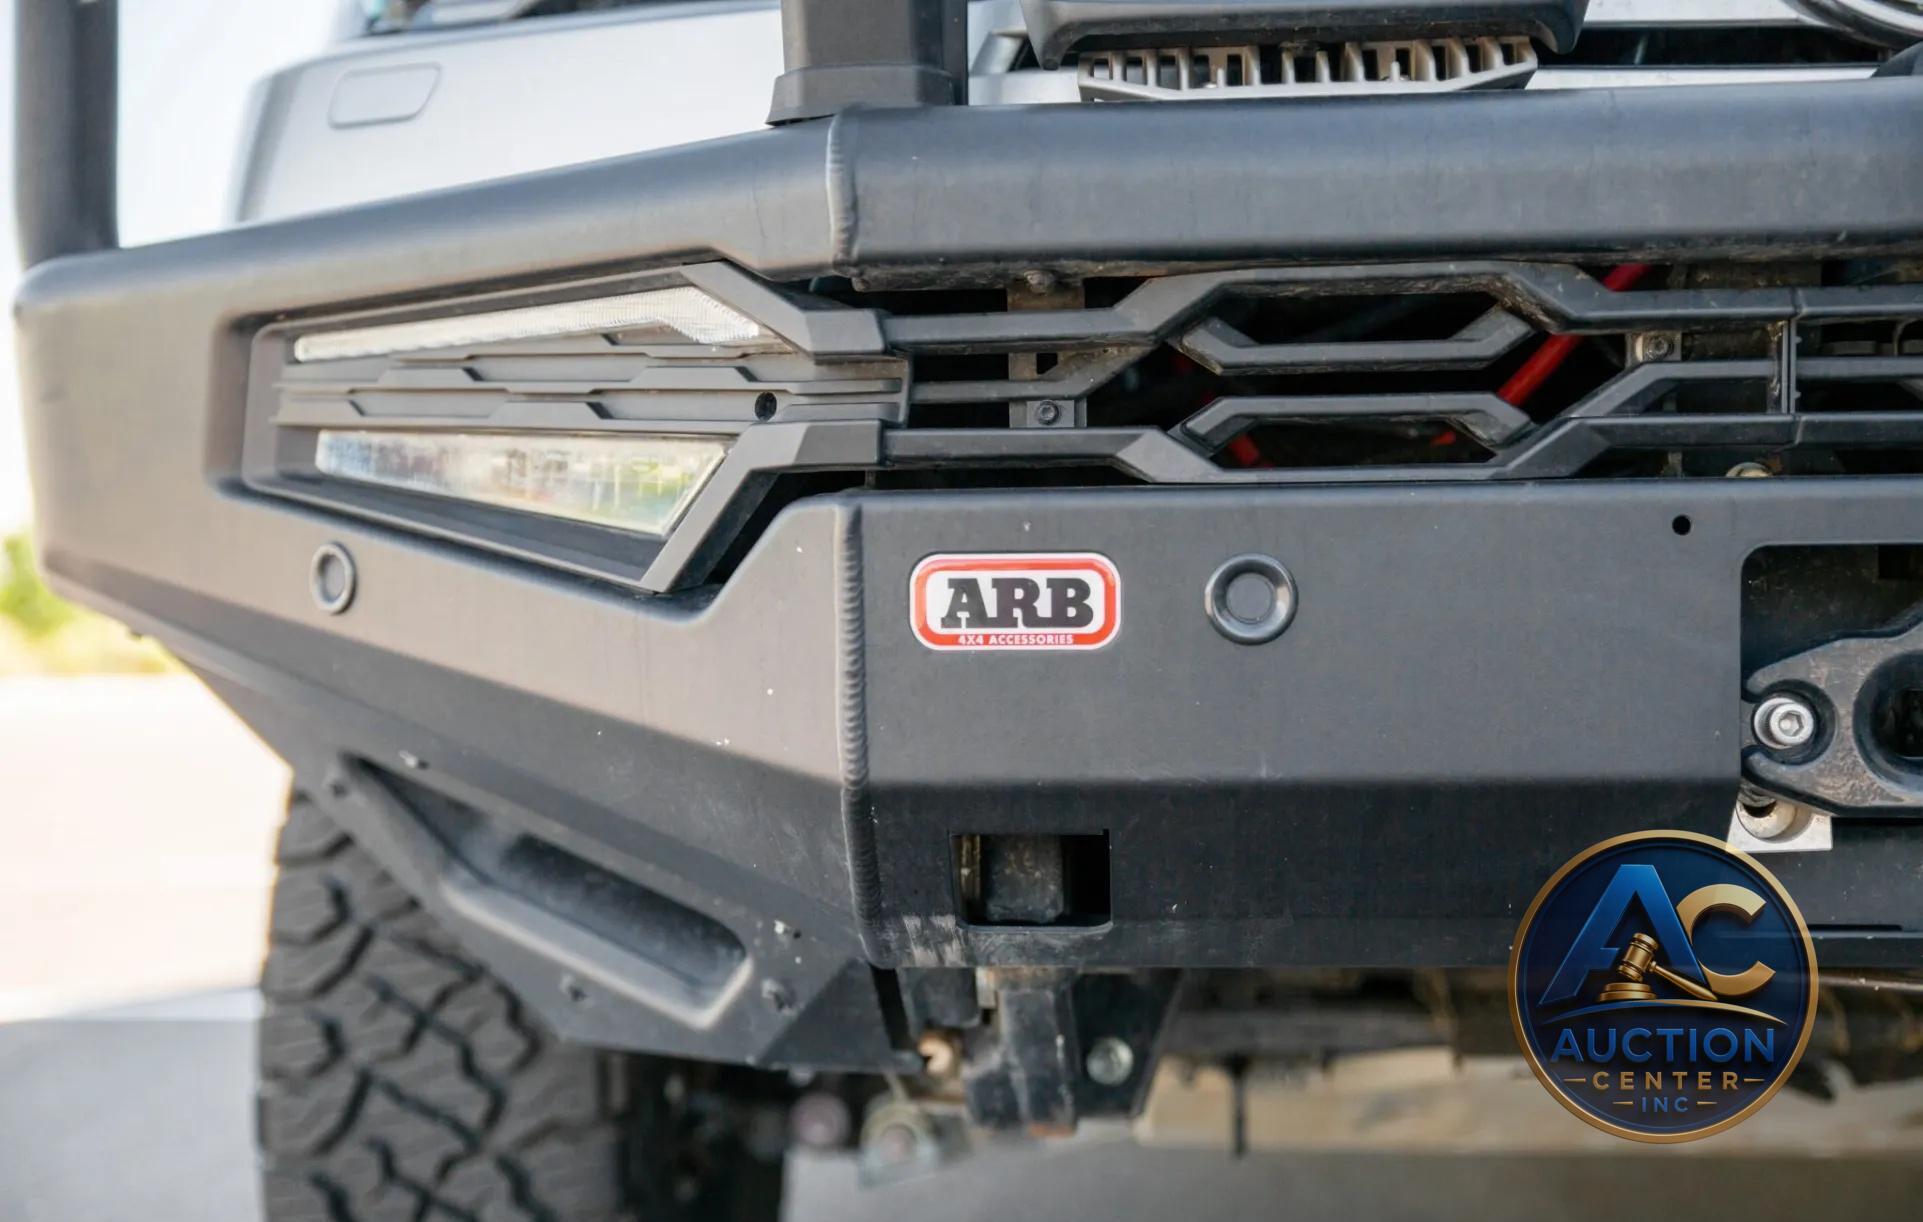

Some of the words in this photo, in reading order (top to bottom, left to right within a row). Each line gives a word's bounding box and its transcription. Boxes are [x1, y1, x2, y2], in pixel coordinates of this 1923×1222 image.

[941, 577, 1094, 629] ARB
[958, 634, 984, 645] 4X4
[988, 634, 1074, 645] ACCESSORIES
